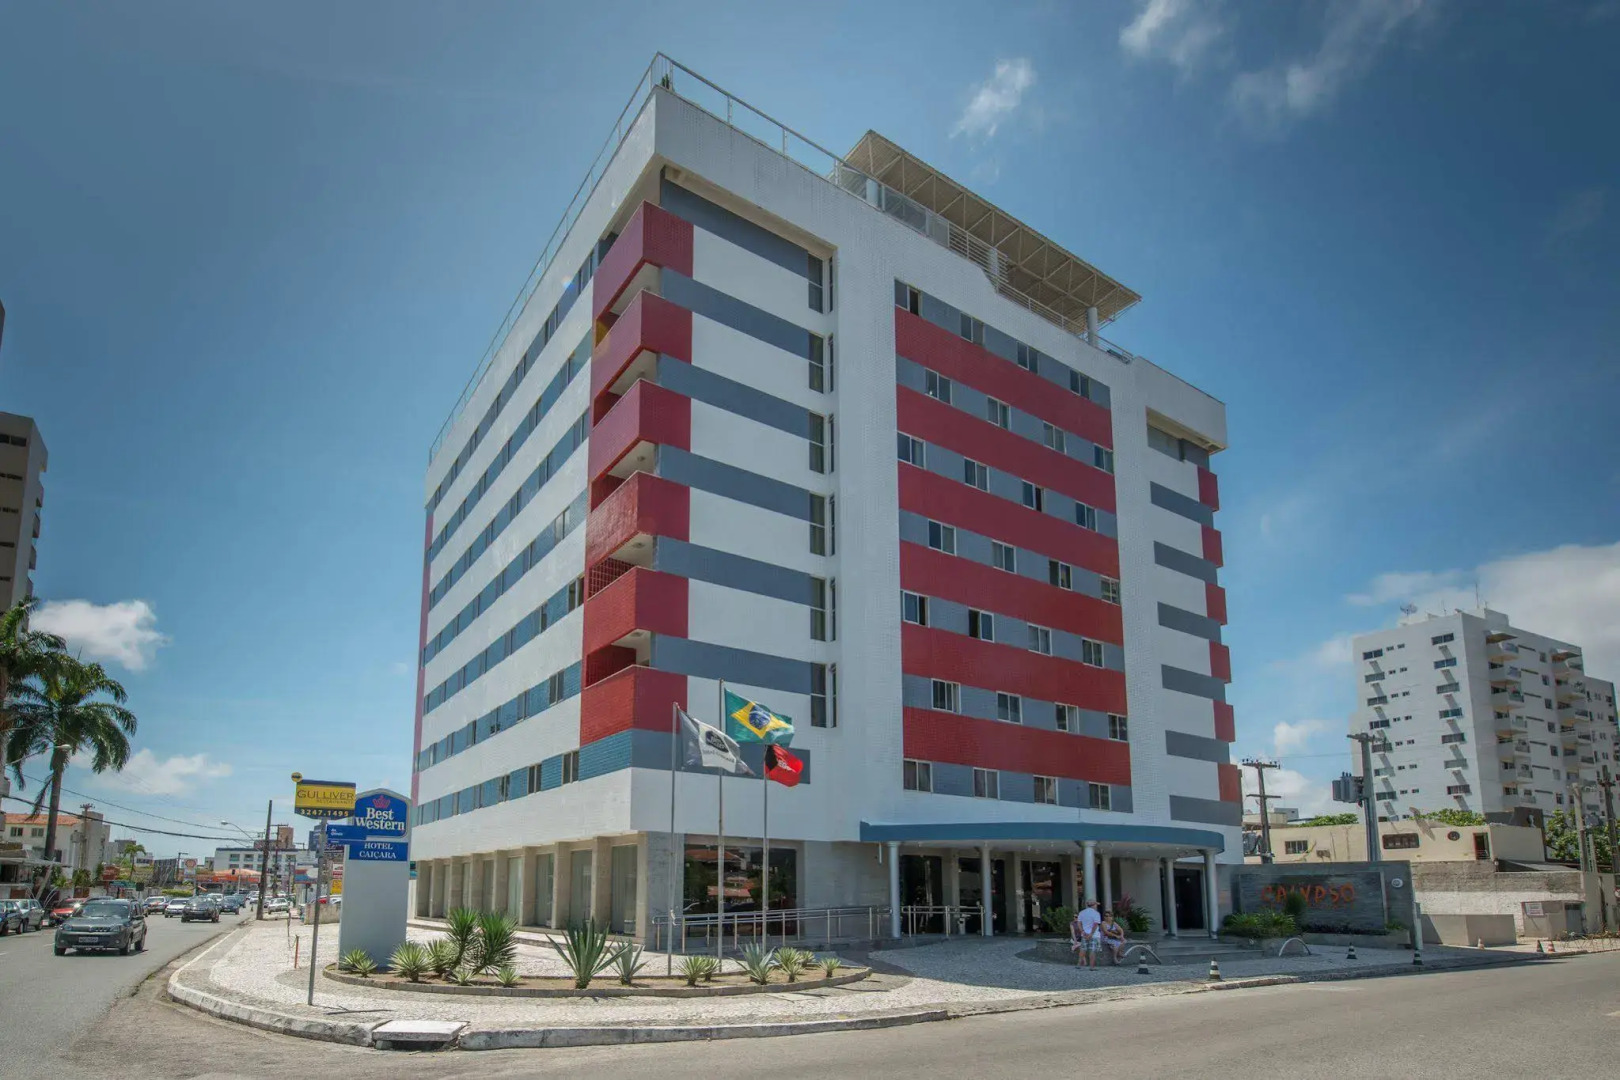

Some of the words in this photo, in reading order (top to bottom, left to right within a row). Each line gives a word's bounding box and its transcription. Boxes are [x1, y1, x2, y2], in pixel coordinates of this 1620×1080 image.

[297, 790, 354, 800] GULLIVER
[366, 807, 394, 820] Best
[355, 817, 405, 831] Western
[364, 842, 394, 850] HOTEL
[359, 851, 396, 859] CAIÇARA
